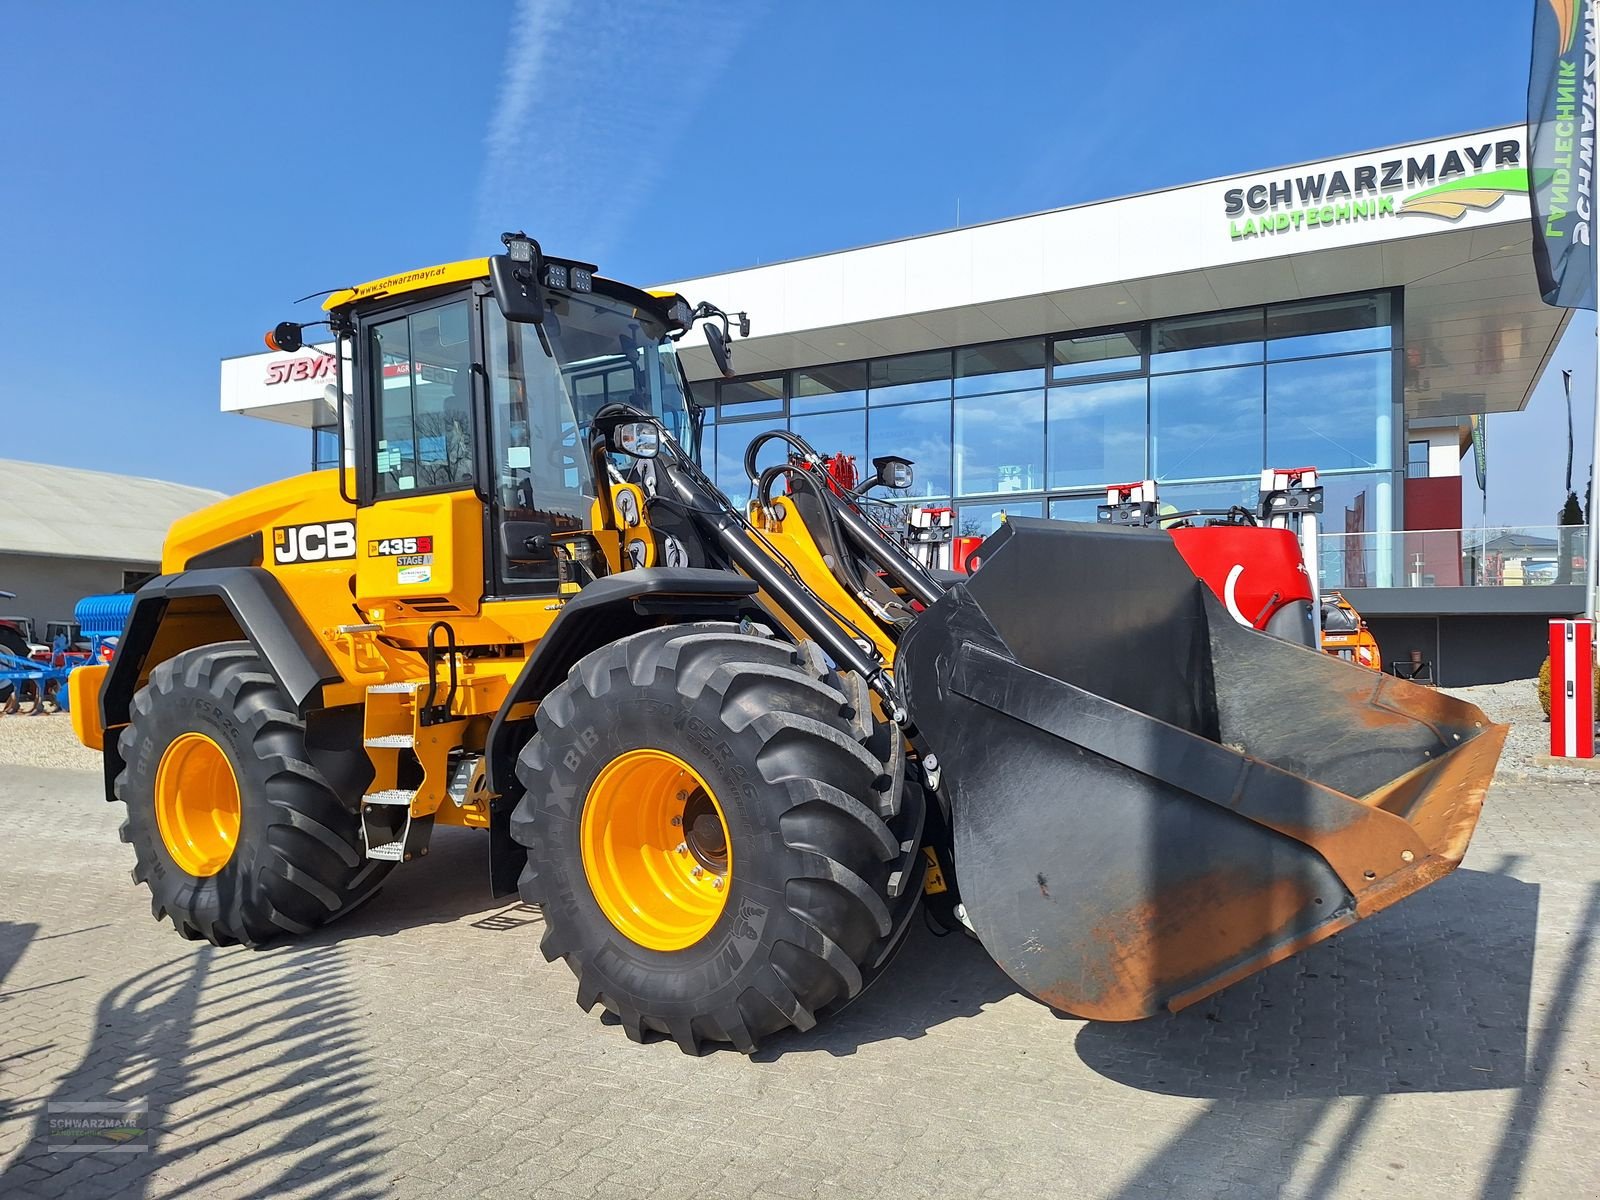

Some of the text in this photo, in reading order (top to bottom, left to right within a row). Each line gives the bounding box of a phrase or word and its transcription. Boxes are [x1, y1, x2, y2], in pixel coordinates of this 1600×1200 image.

[1224, 139, 1521, 215] SCHWARZMAYR
[1229, 195, 1396, 239] LANDTECHNIK
[360, 266, 446, 296] www.schwarzmayr.at
[275, 521, 356, 563] JCB
[378, 537, 431, 556] 435S
[397, 555, 423, 566] STAGE
